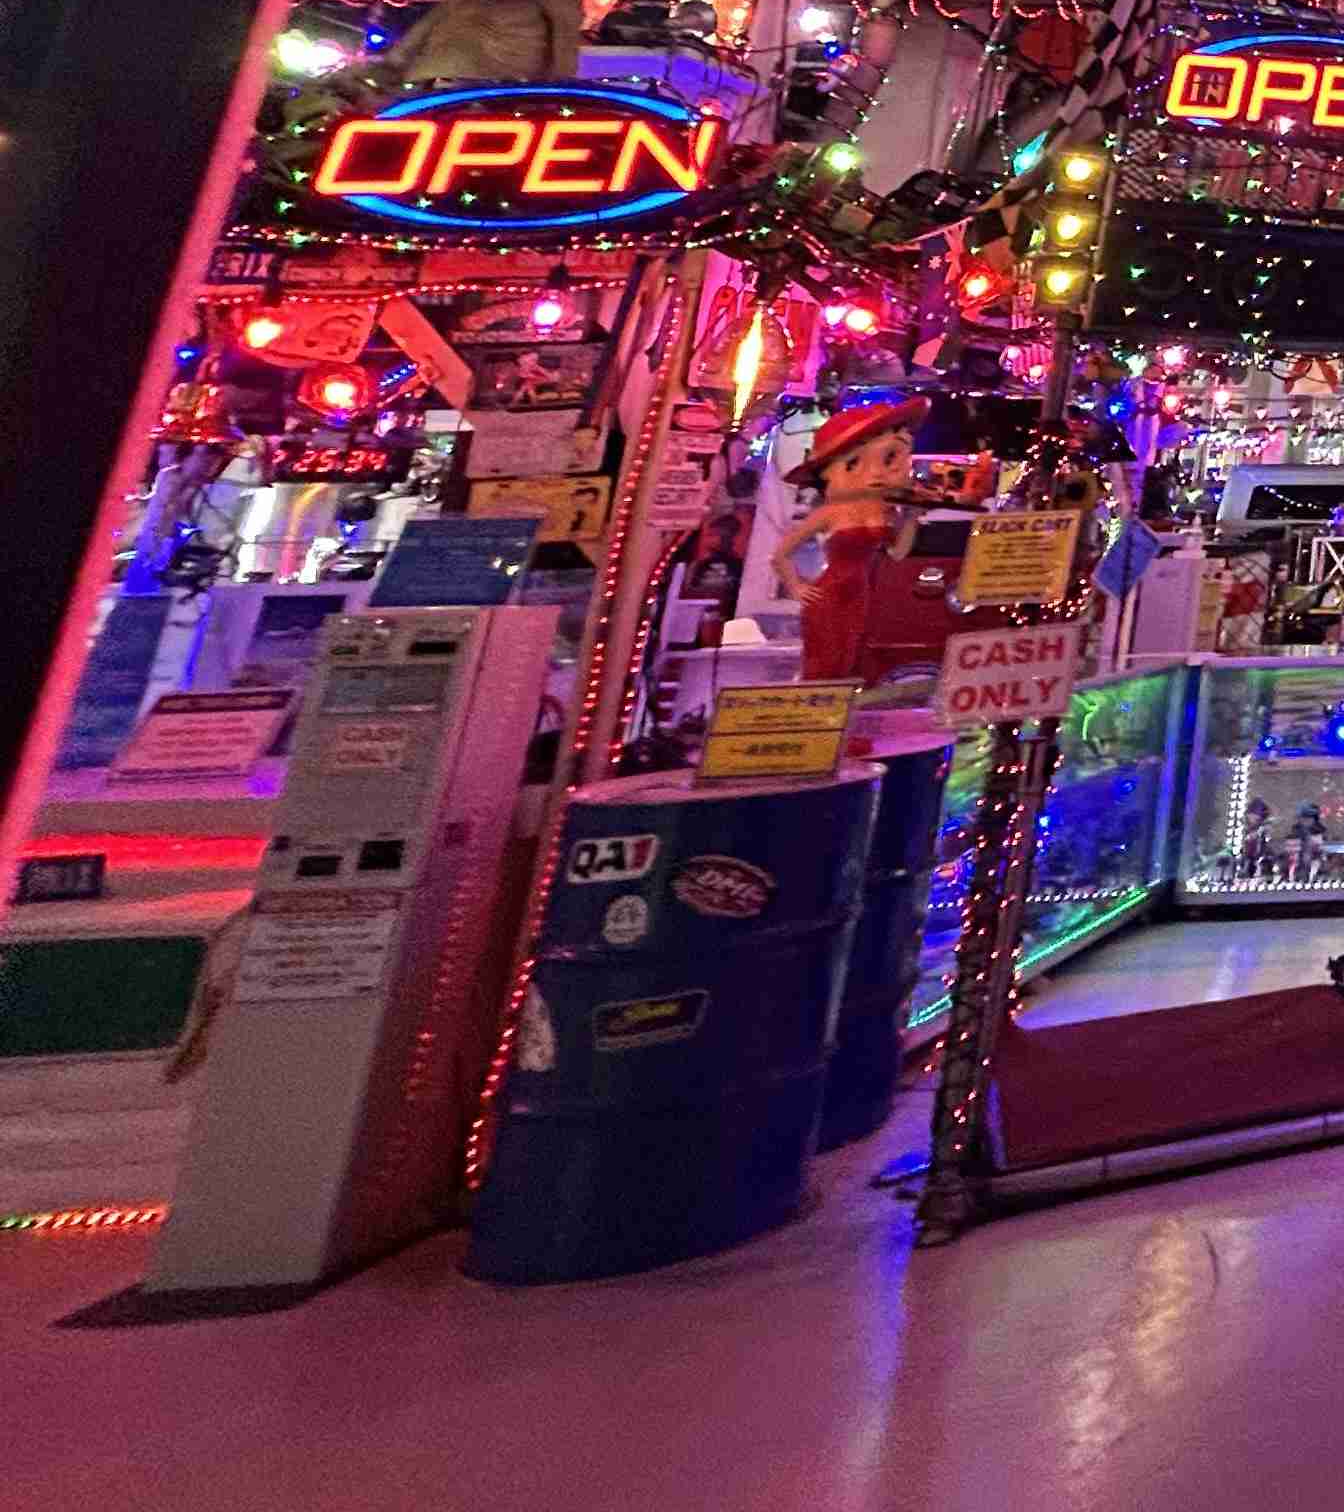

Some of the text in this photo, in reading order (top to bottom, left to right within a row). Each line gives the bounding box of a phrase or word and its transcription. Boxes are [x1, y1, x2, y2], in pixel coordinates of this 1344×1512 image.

[315, 118, 720, 196] OPEN
[957, 635, 1065, 671] CASH
[951, 677, 1059, 713] ONLY
